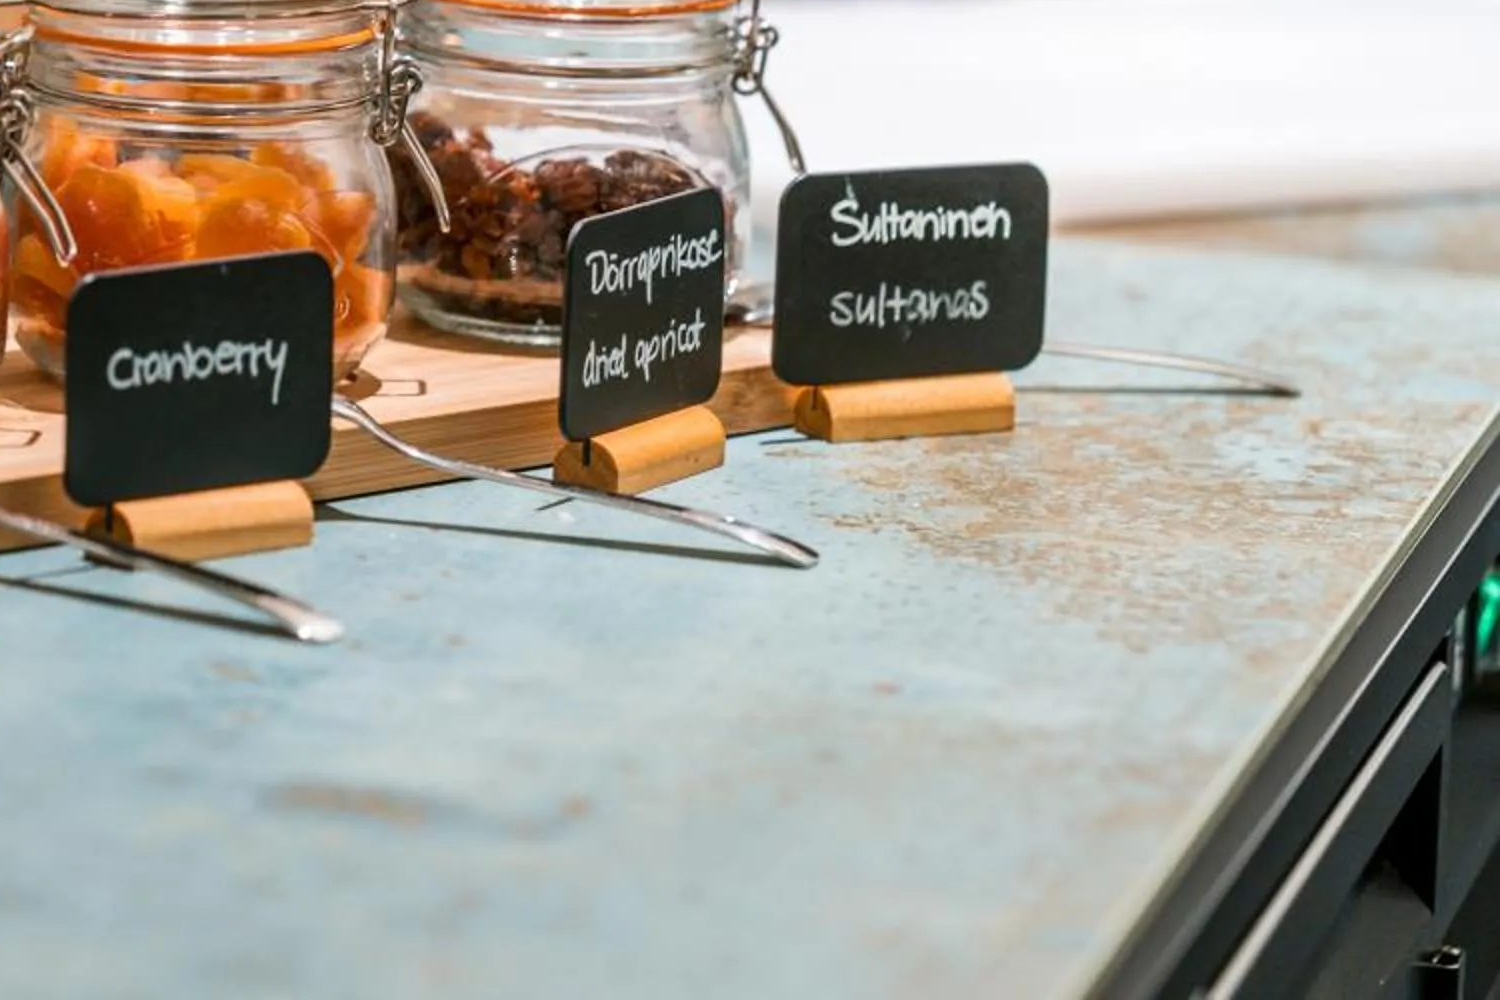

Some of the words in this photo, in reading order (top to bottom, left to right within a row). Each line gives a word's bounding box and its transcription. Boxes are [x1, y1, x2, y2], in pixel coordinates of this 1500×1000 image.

[830, 199, 1012, 247] Sultaninen
[585, 228, 723, 304] Dörraprikose
[106, 338, 288, 405] Cranberry
[582, 333, 629, 388] dried
[634, 307, 707, 382] apricot
